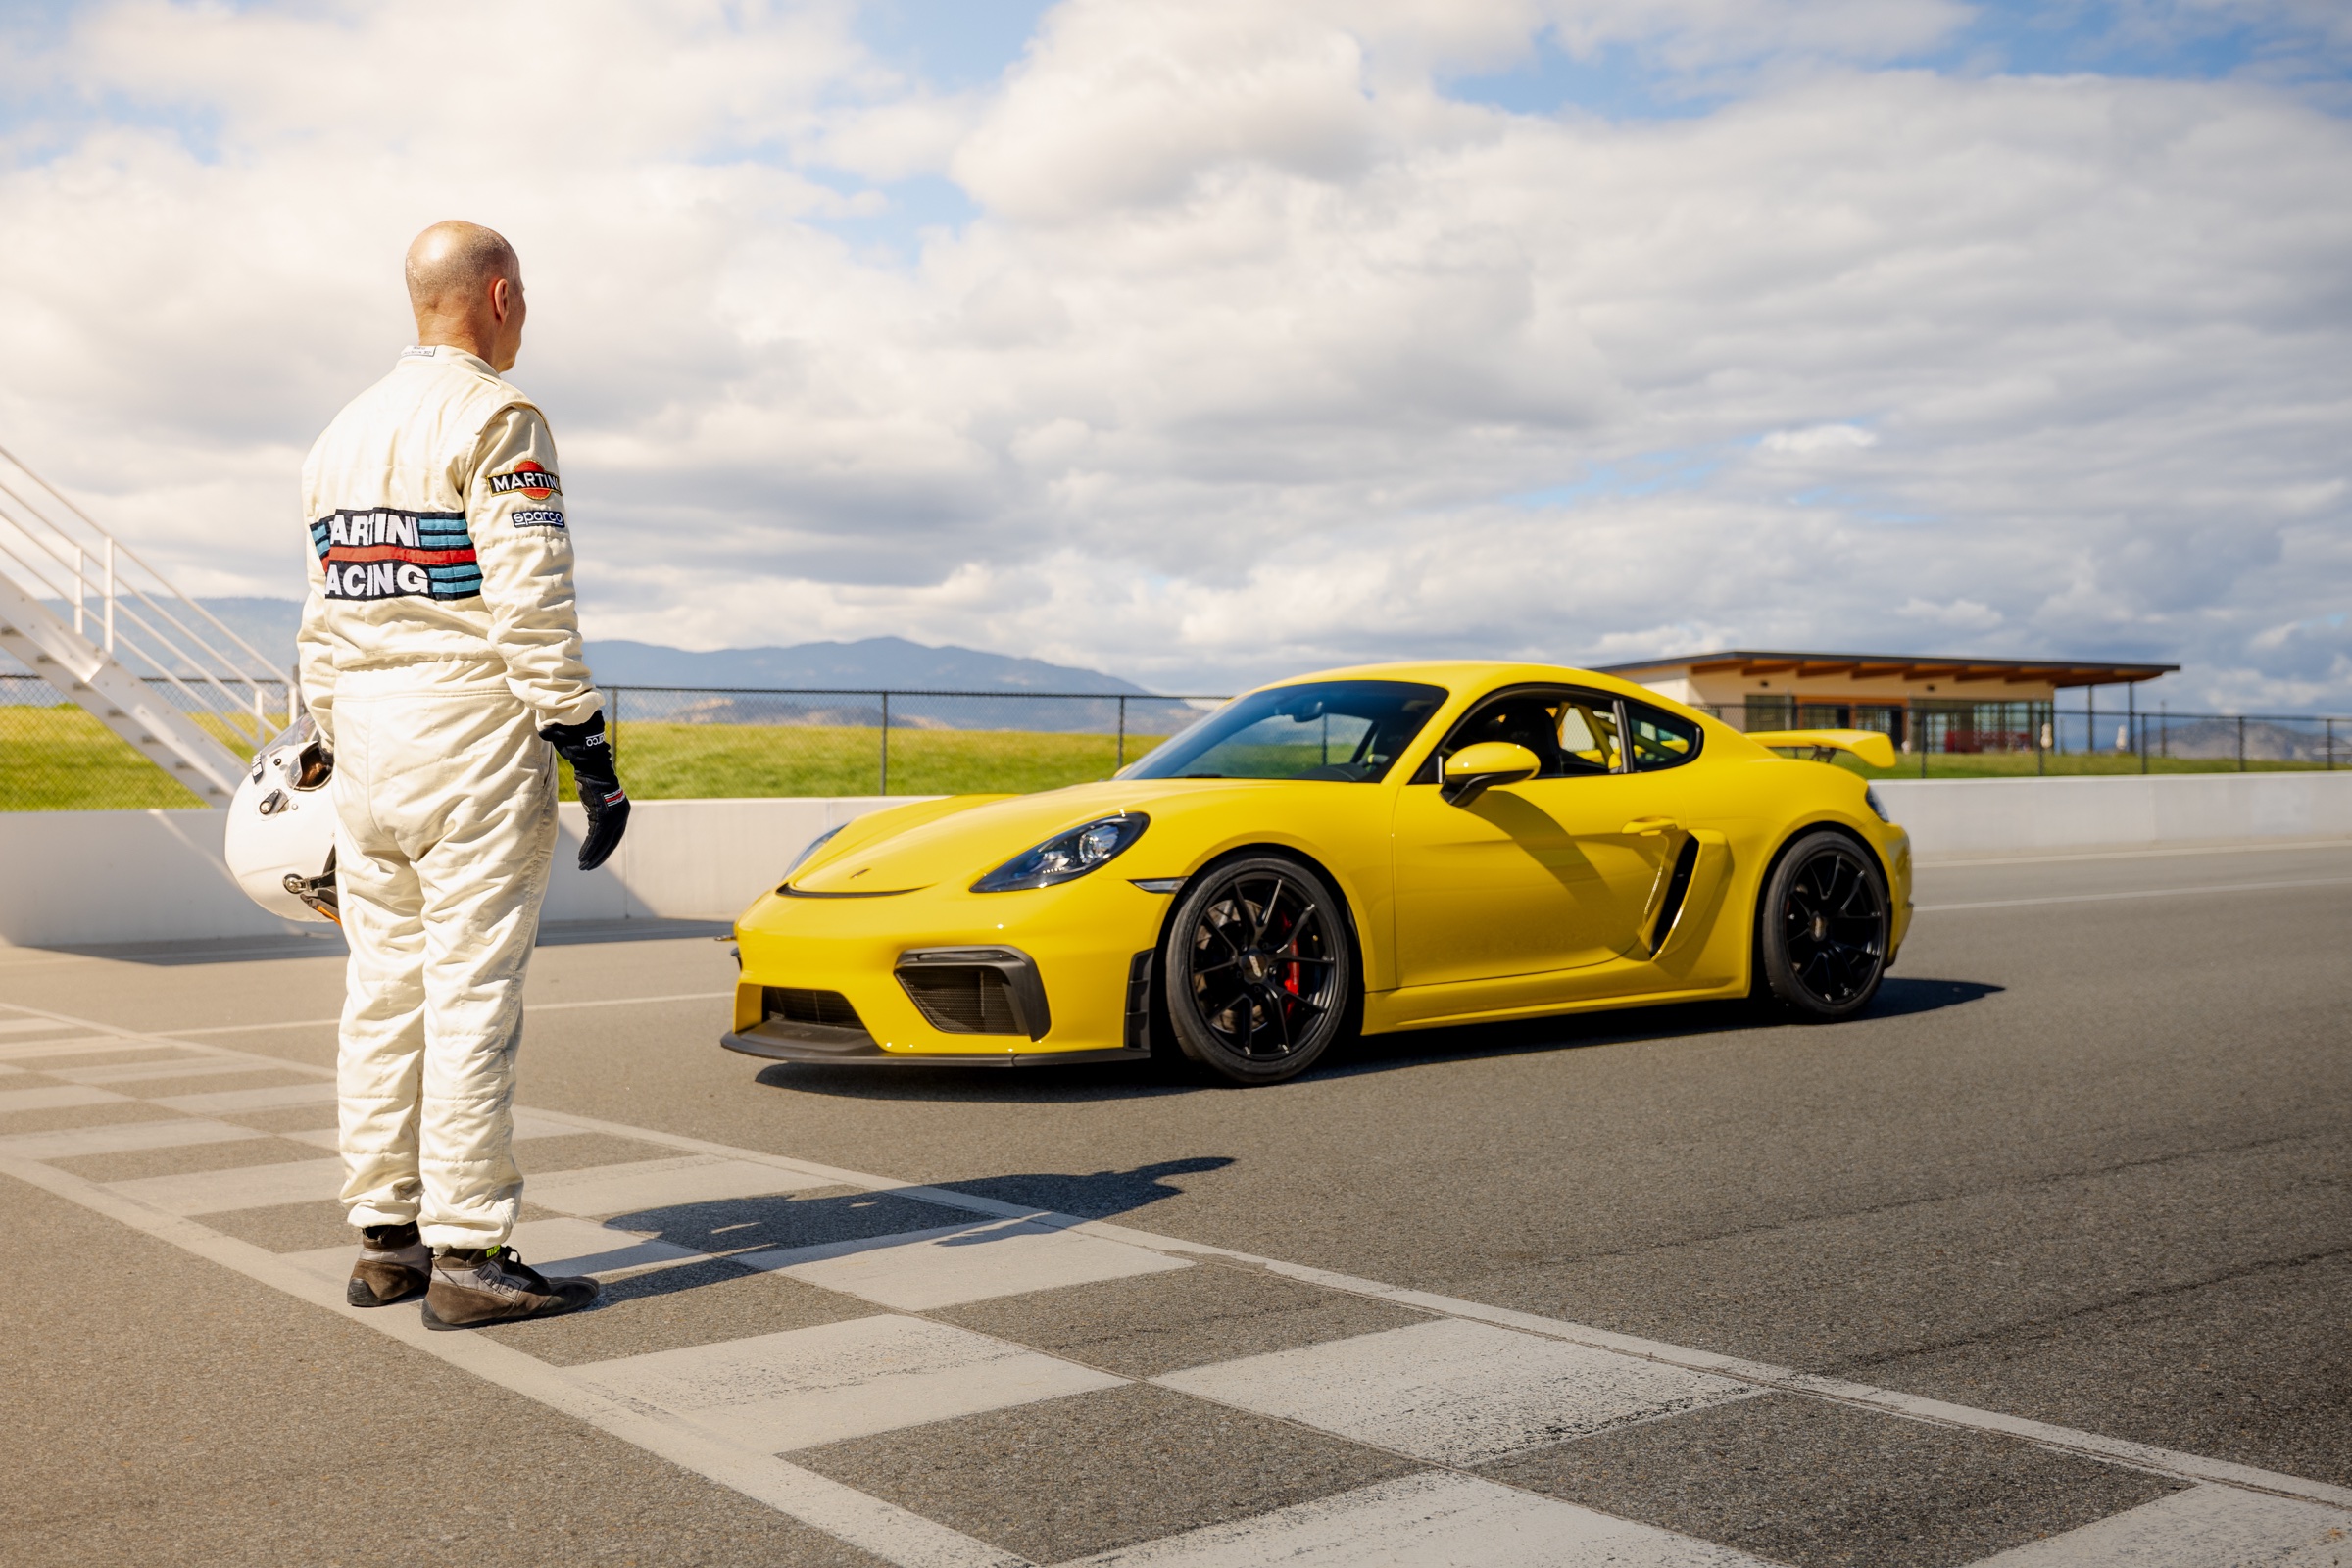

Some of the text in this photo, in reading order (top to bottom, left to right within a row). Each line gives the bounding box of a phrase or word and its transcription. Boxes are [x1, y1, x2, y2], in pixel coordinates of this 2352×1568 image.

[328, 513, 421, 548] ARTINI
[514, 512, 564, 526] sparco
[325, 563, 429, 597] ACING
